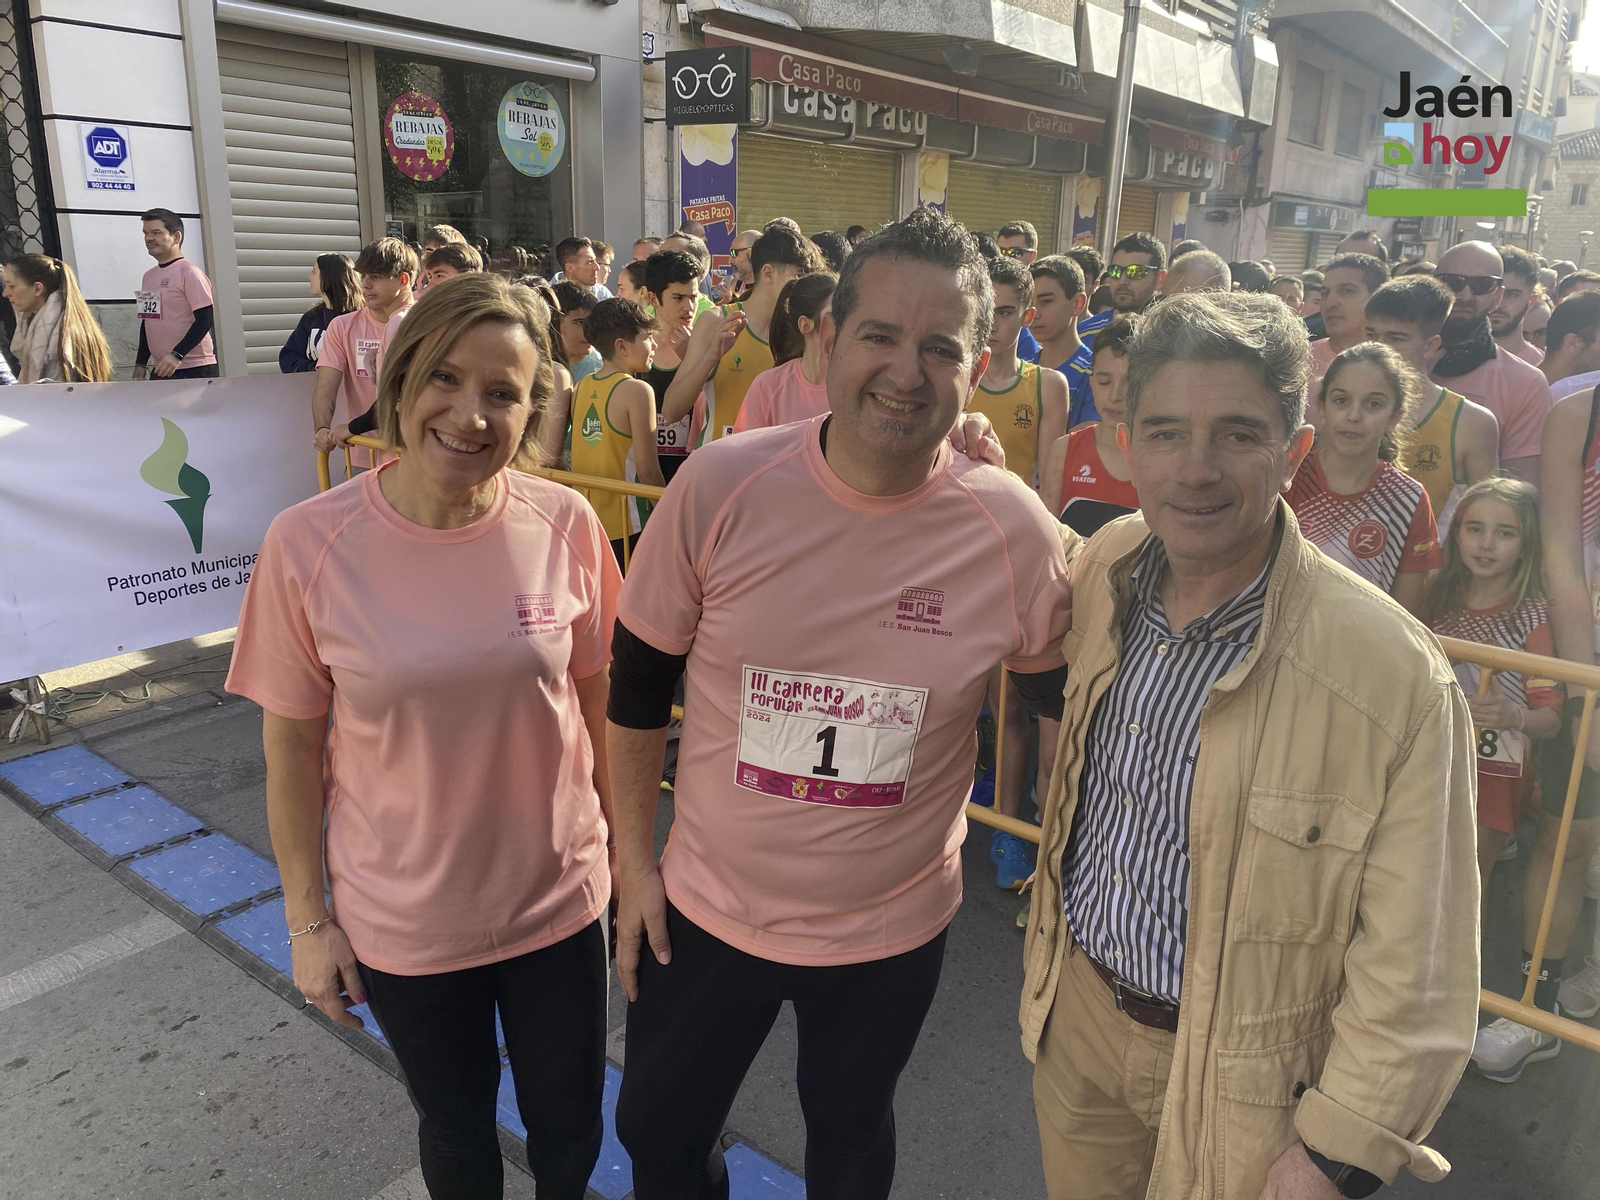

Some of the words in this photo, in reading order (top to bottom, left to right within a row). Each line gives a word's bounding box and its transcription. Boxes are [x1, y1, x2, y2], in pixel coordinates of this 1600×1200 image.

[779, 55, 820, 83] Casa
[826, 65, 861, 92] Paco
[395, 121, 444, 135] REBAJAS
[508, 109, 556, 130] REBAJAS
[1027, 111, 1051, 132] Casa
[1052, 116, 1073, 134] Paco
[521, 127, 538, 142] Sol
[94, 140, 120, 155] ADT
[690, 197, 709, 206] PATATAS
[710, 195, 726, 203] FRITAS
[690, 210, 710, 221] Casa
[711, 207, 731, 217] Paco
[143, 301, 157, 313] 342
[582, 418, 601, 435] Jaén
[657, 429, 676, 446] 59
[1072, 476, 1097, 484] VIATOR
[107, 566, 187, 591] Patronato
[191, 553, 259, 575] Municipa
[134, 582, 207, 606] Deportes
[211, 575, 230, 590] de
[235, 570, 251, 585] Ja
[897, 623, 912, 631] San
[913, 626, 930, 634] Juan
[932, 628, 953, 637] Bosco
[751, 672, 768, 692] III
[826, 704, 843, 720] JUAN
[844, 694, 865, 721] BOSCO
[746, 712, 771, 723] 2024
[812, 726, 839, 777] 1
[1478, 729, 1499, 758] 8
